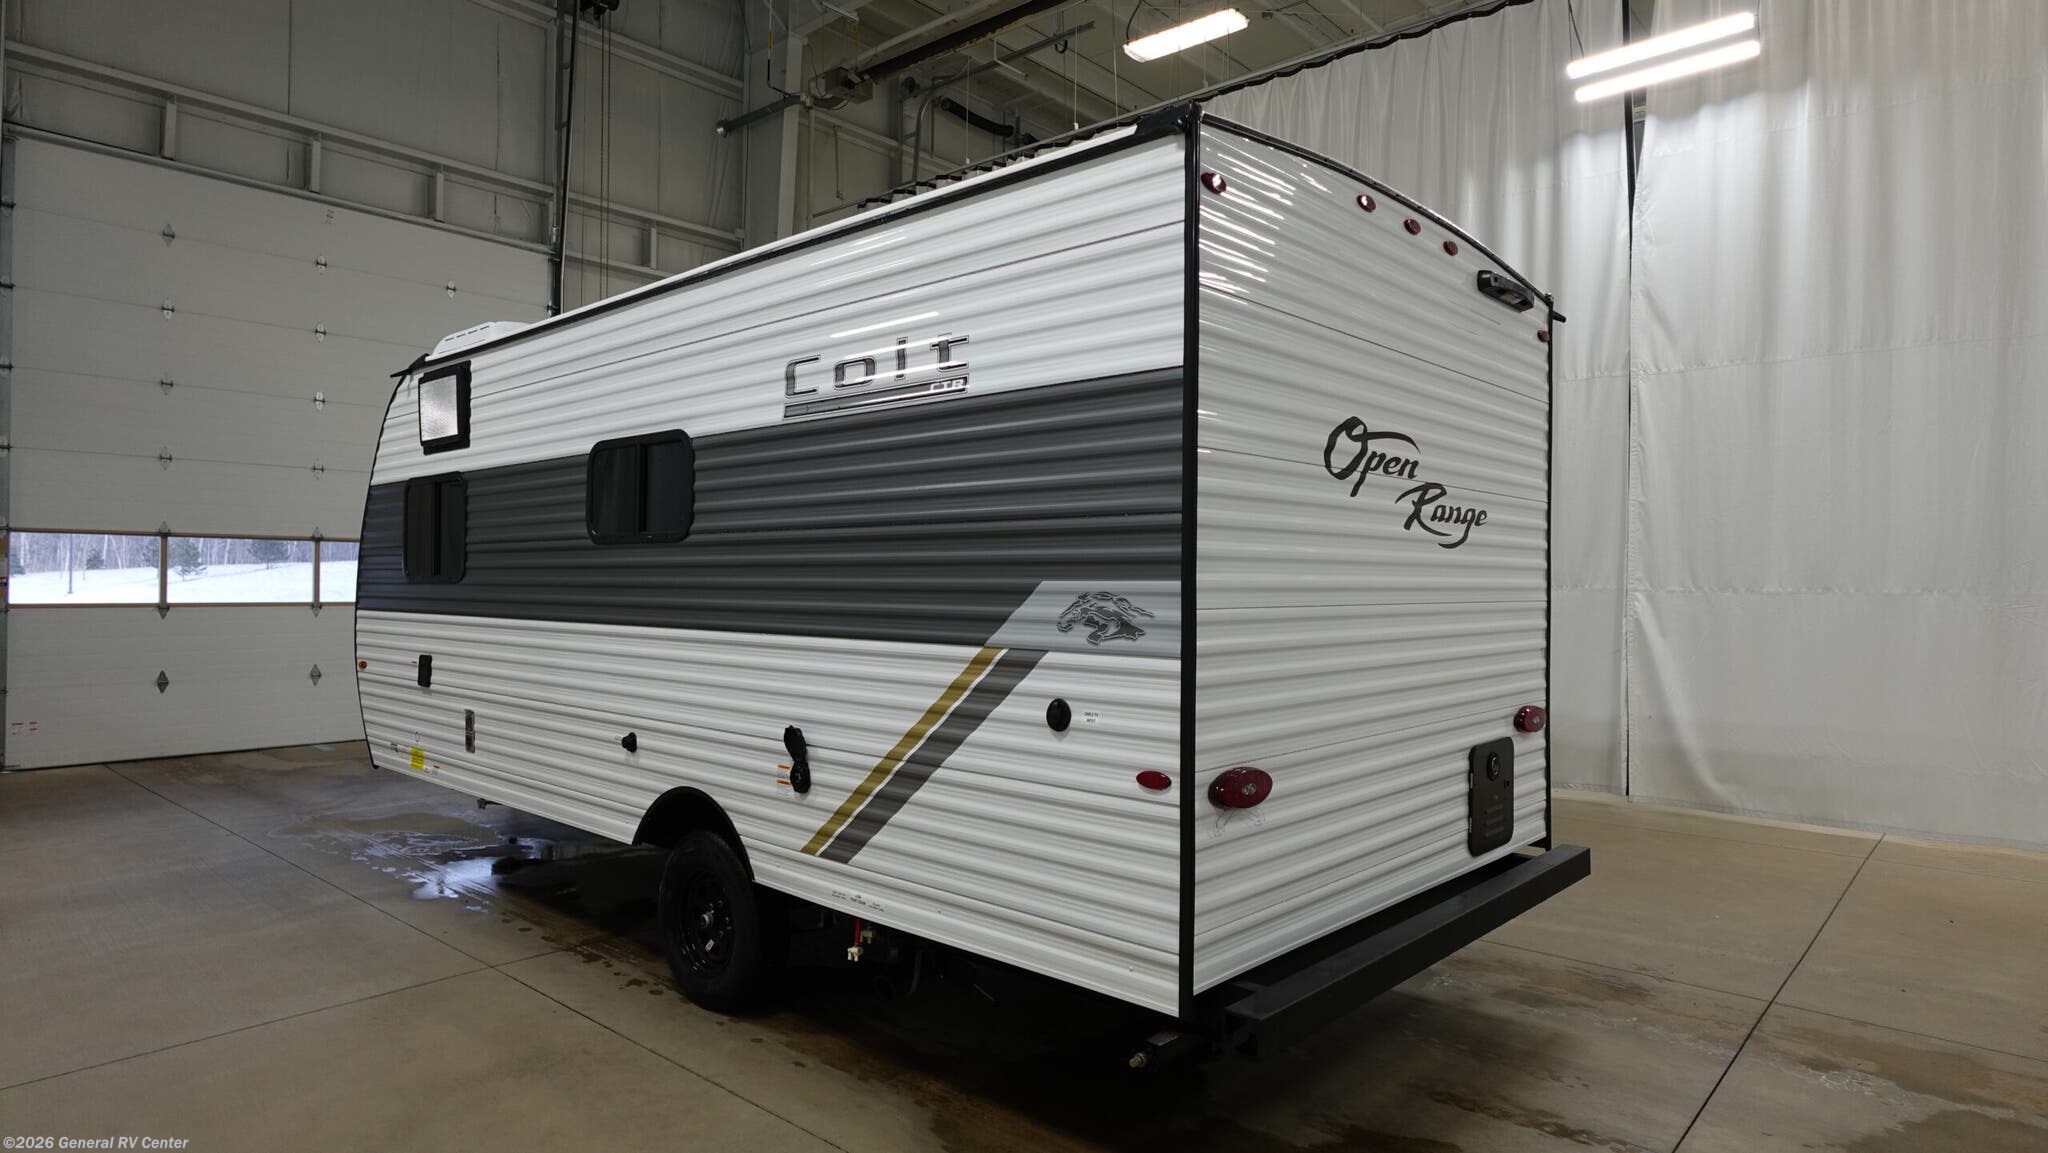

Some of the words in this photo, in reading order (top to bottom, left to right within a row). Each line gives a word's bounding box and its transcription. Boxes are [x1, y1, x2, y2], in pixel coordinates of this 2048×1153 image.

[785, 333, 969, 398] Colt
[1324, 416, 1421, 498] Open
[1395, 482, 1488, 549] Range
